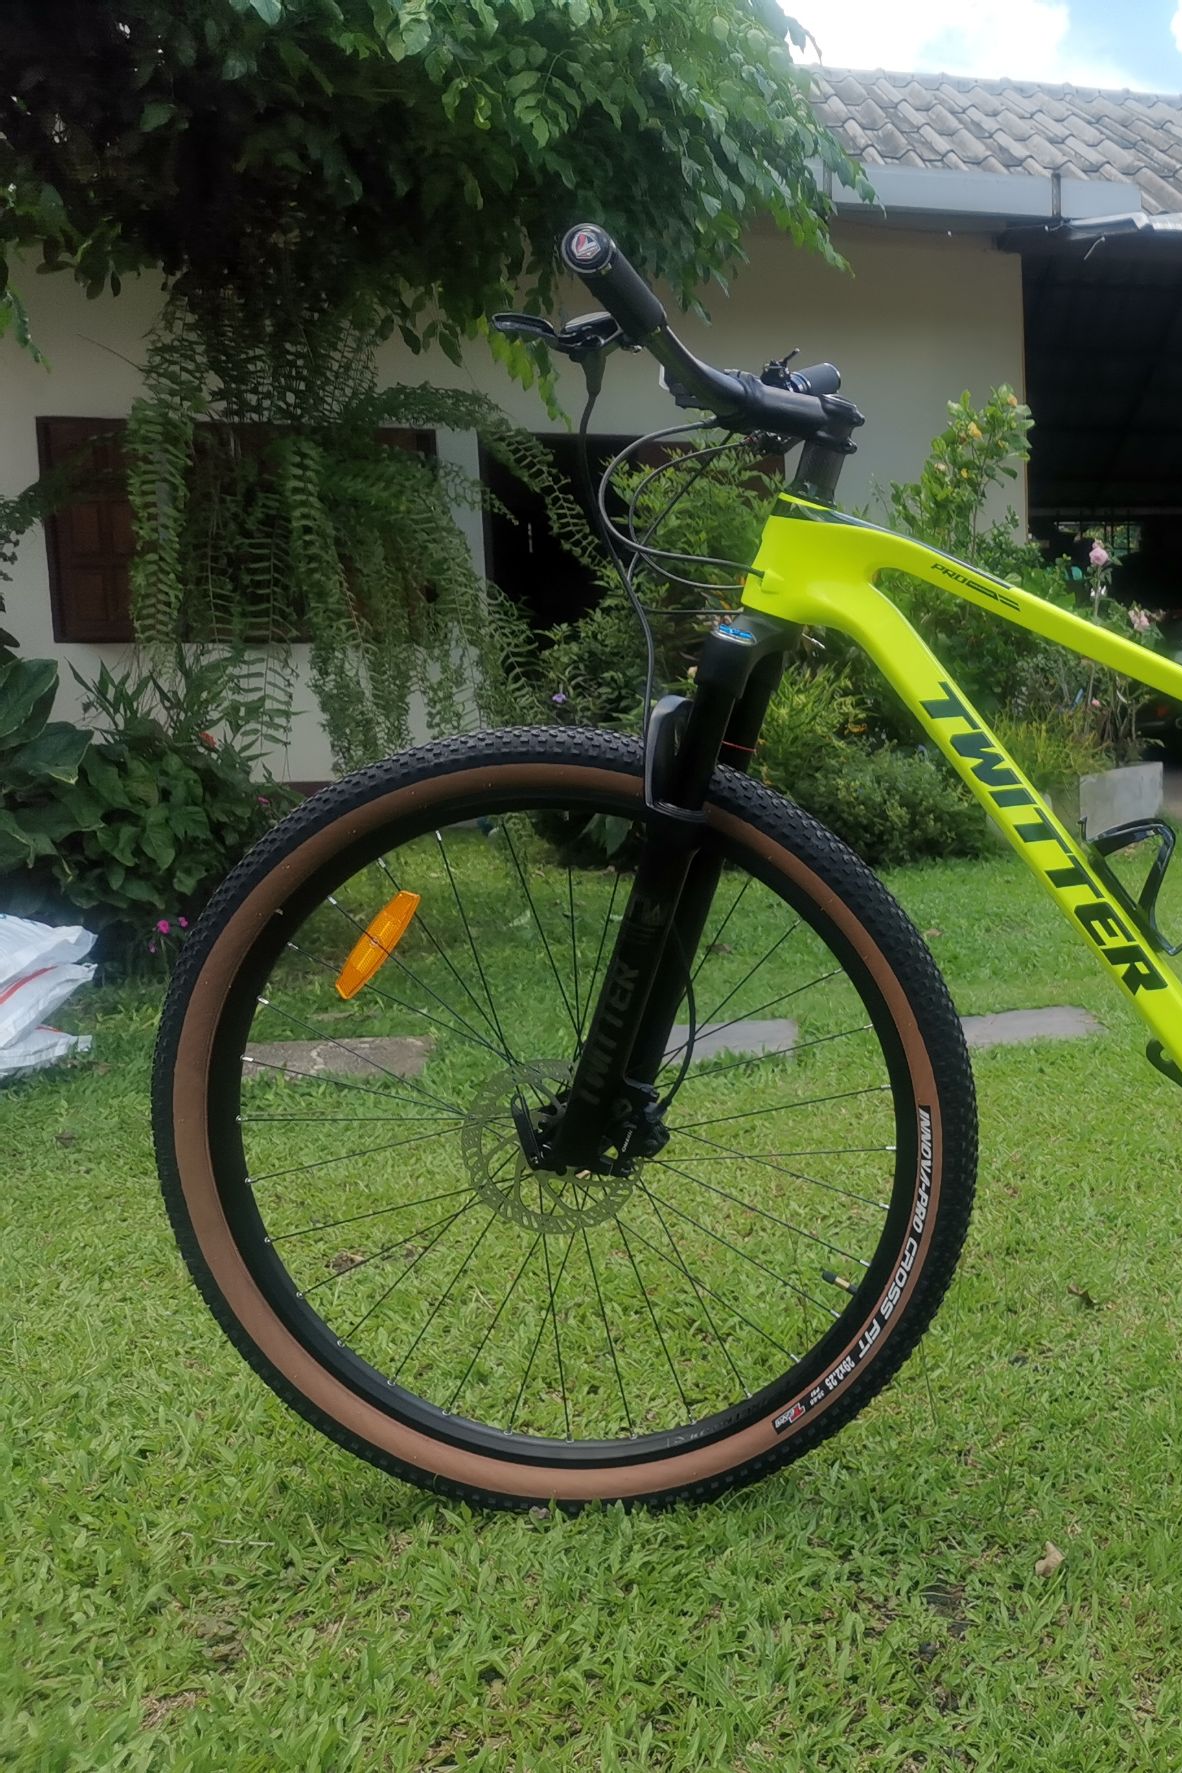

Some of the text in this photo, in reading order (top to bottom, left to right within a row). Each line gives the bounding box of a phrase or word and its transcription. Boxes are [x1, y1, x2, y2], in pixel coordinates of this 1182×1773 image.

[918, 681, 1168, 996] TWITTER
[575, 959, 640, 1105] TWITTER
[912, 1109, 932, 1233] INNOVA-PRO
[880, 1236, 918, 1321] CROSS
[824, 1355, 855, 1391] 29x2.25
[858, 1323, 882, 1358] FIT
